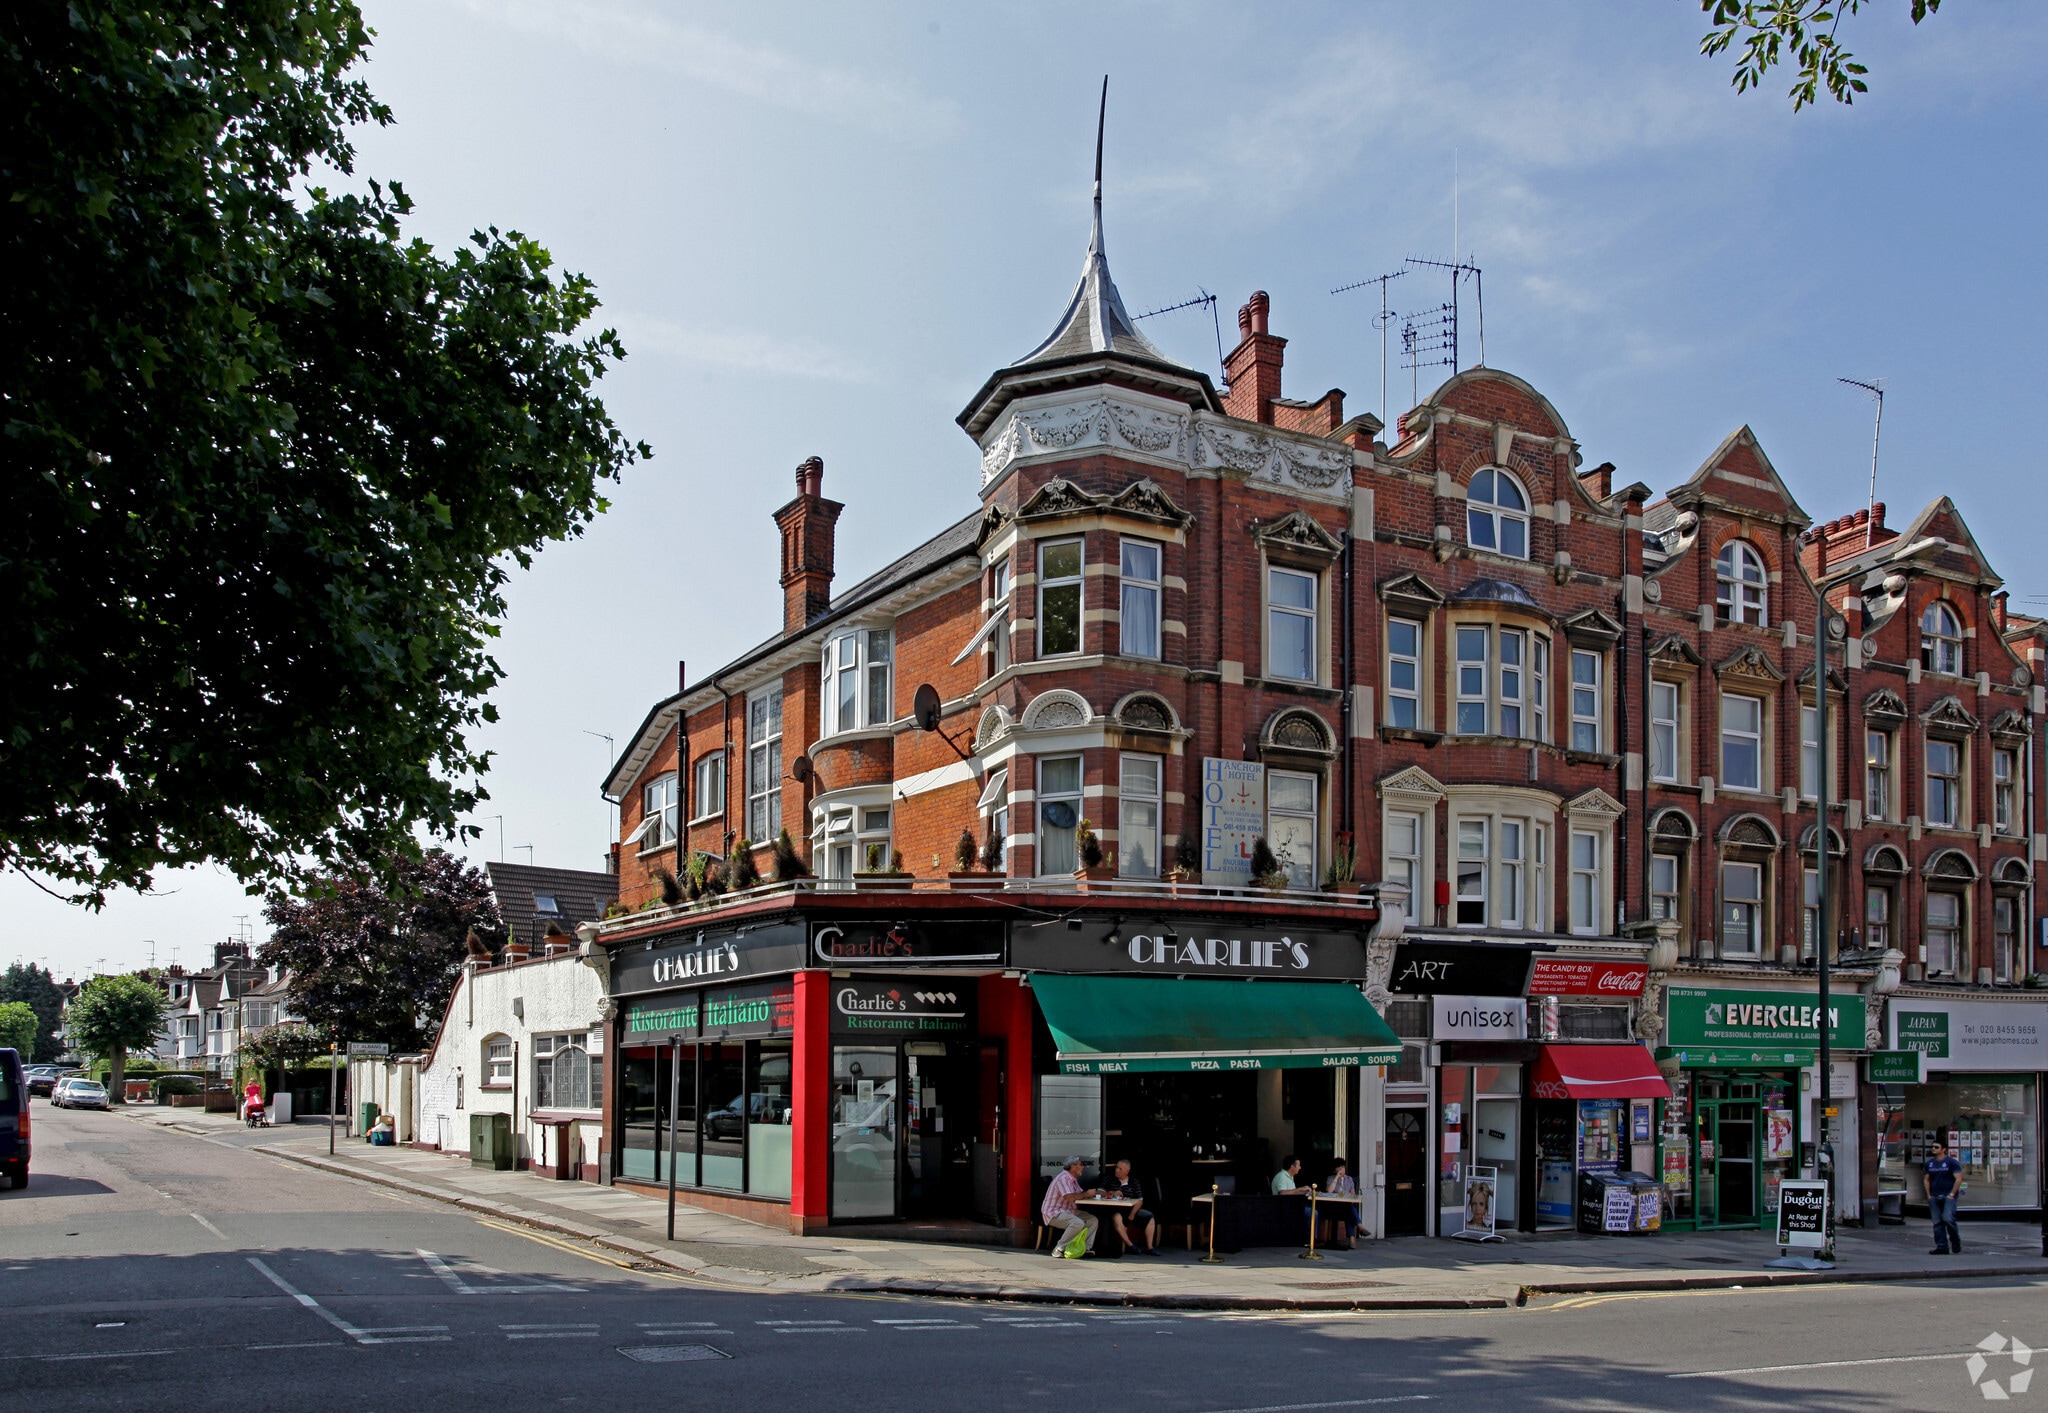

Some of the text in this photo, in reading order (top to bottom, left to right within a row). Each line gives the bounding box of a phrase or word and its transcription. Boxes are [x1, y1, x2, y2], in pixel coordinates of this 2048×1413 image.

[1224, 762, 1262, 774] ANCHOR
[1228, 771, 1257, 782] HOTEL
[1205, 760, 1224, 872] HOTEL
[1223, 858, 1250, 867] ENQUIRIE
[815, 927, 914, 962] Charlie's
[1128, 935, 1310, 970] CHARLIE'S
[652, 942, 738, 982] CHARLIE'S
[1399, 960, 1455, 981] ART
[1598, 971, 1646, 990] Coca-Cola
[837, 988, 906, 1014] Charlie's
[631, 994, 770, 1033] Ristorante Italiano
[1447, 1007, 1514, 1028] unisex
[1726, 1004, 1838, 1030] EVERCLEAN
[848, 1016, 967, 1030] Ristorante Italiano
[1908, 1017, 1937, 1028] JAPAN
[1964, 1025, 2036, 1034] Tel 020 8455 9656
[1908, 1041, 1940, 1052] HOMES
[1962, 1036, 2039, 1046] www.japanhomes.co.uk
[1066, 1055, 1397, 1072] FISH MEAT PIZZA PASTA SALADS SOUPS
[1874, 1069, 1914, 1077] CLEANER
[1665, 1174, 1686, 1183] 25%
[1784, 1196, 1822, 1206] Dugout
